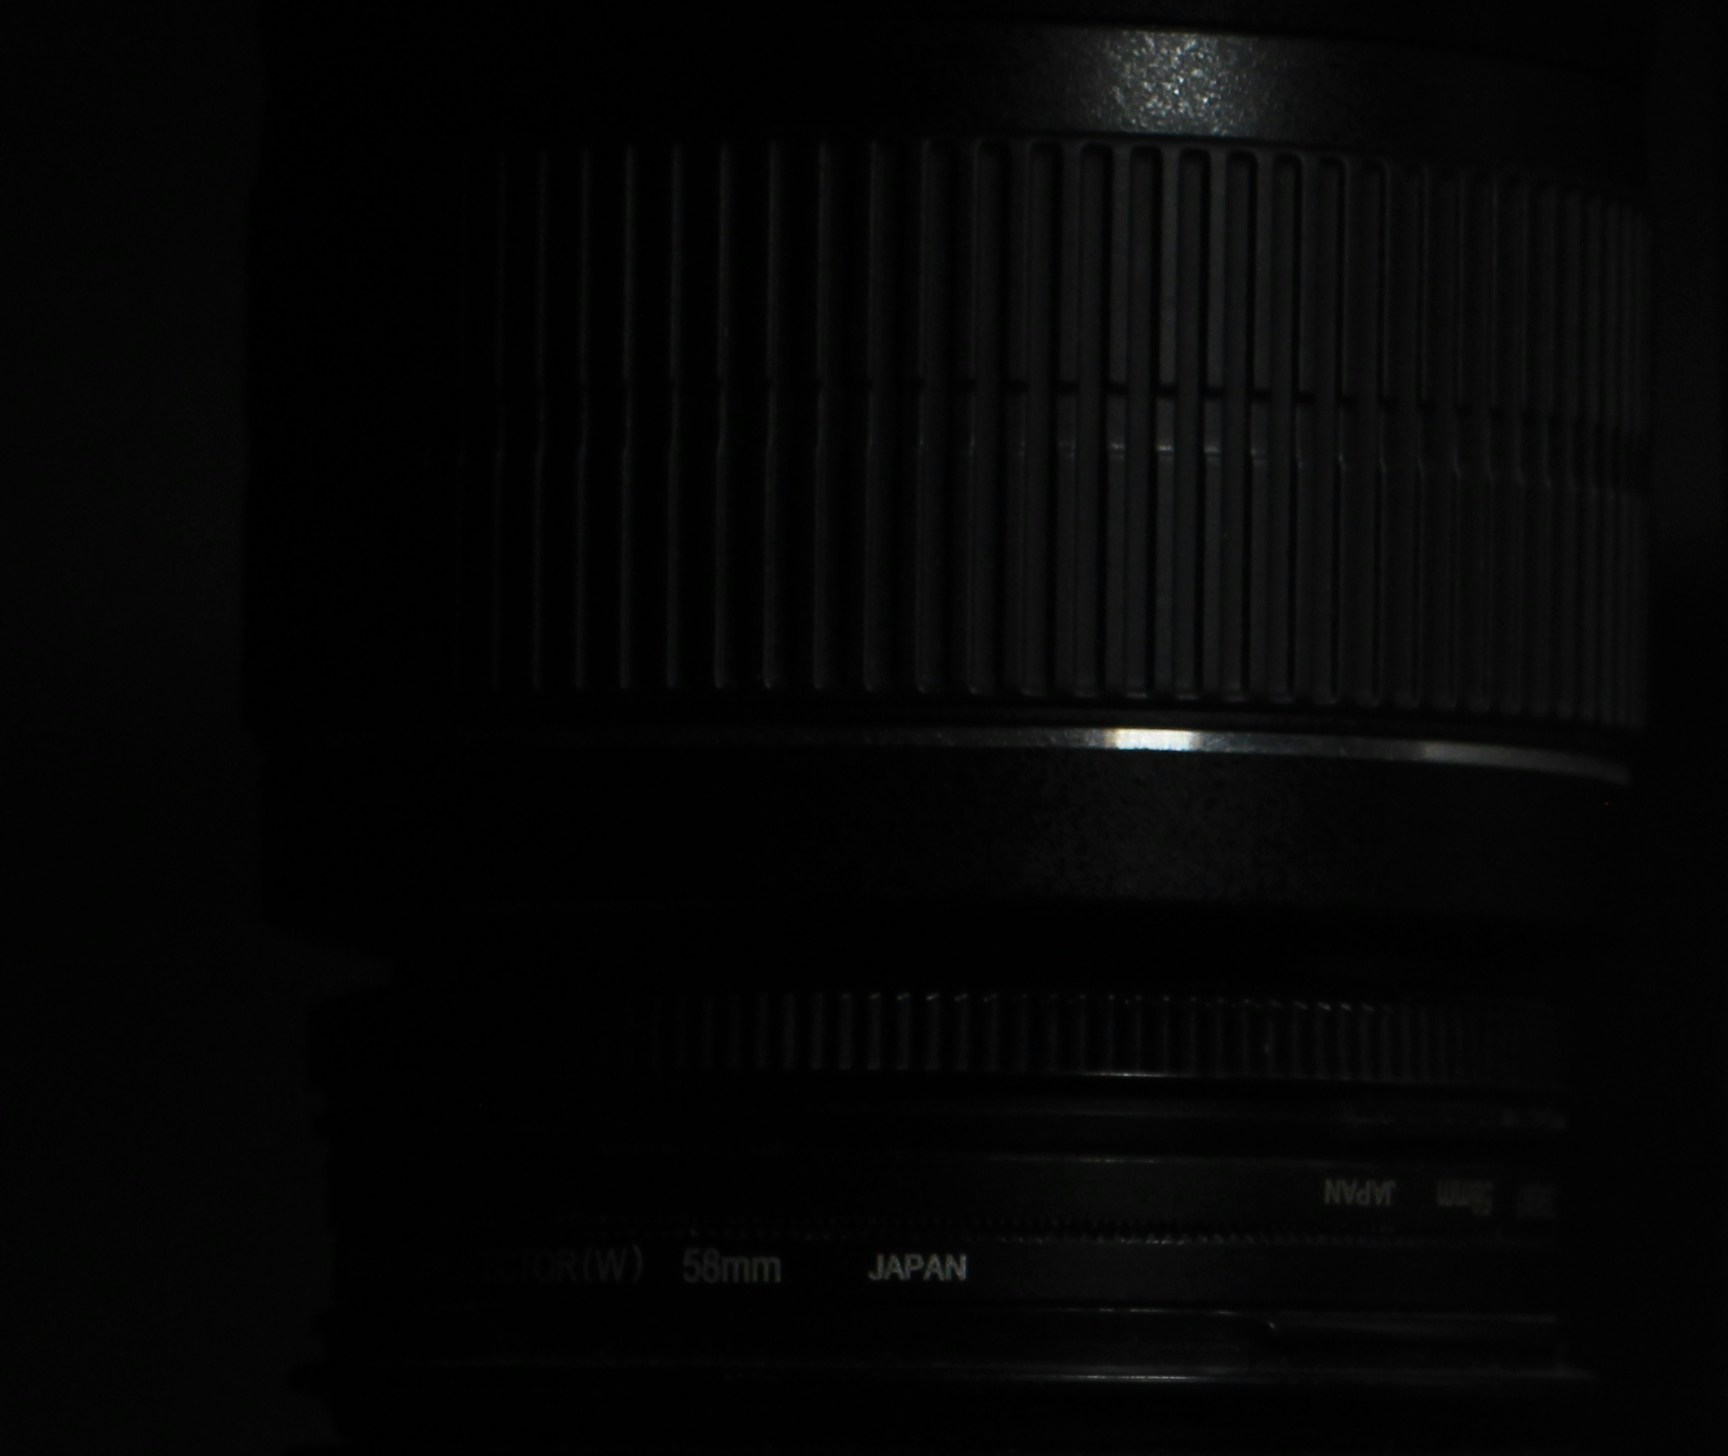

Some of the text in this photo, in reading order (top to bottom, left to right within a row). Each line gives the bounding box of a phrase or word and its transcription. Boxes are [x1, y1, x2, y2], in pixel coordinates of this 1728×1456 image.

[1323, 1177, 1398, 1208] JAPAN
[682, 1247, 784, 1286] 58mm
[866, 1251, 970, 1284] JAPAN
